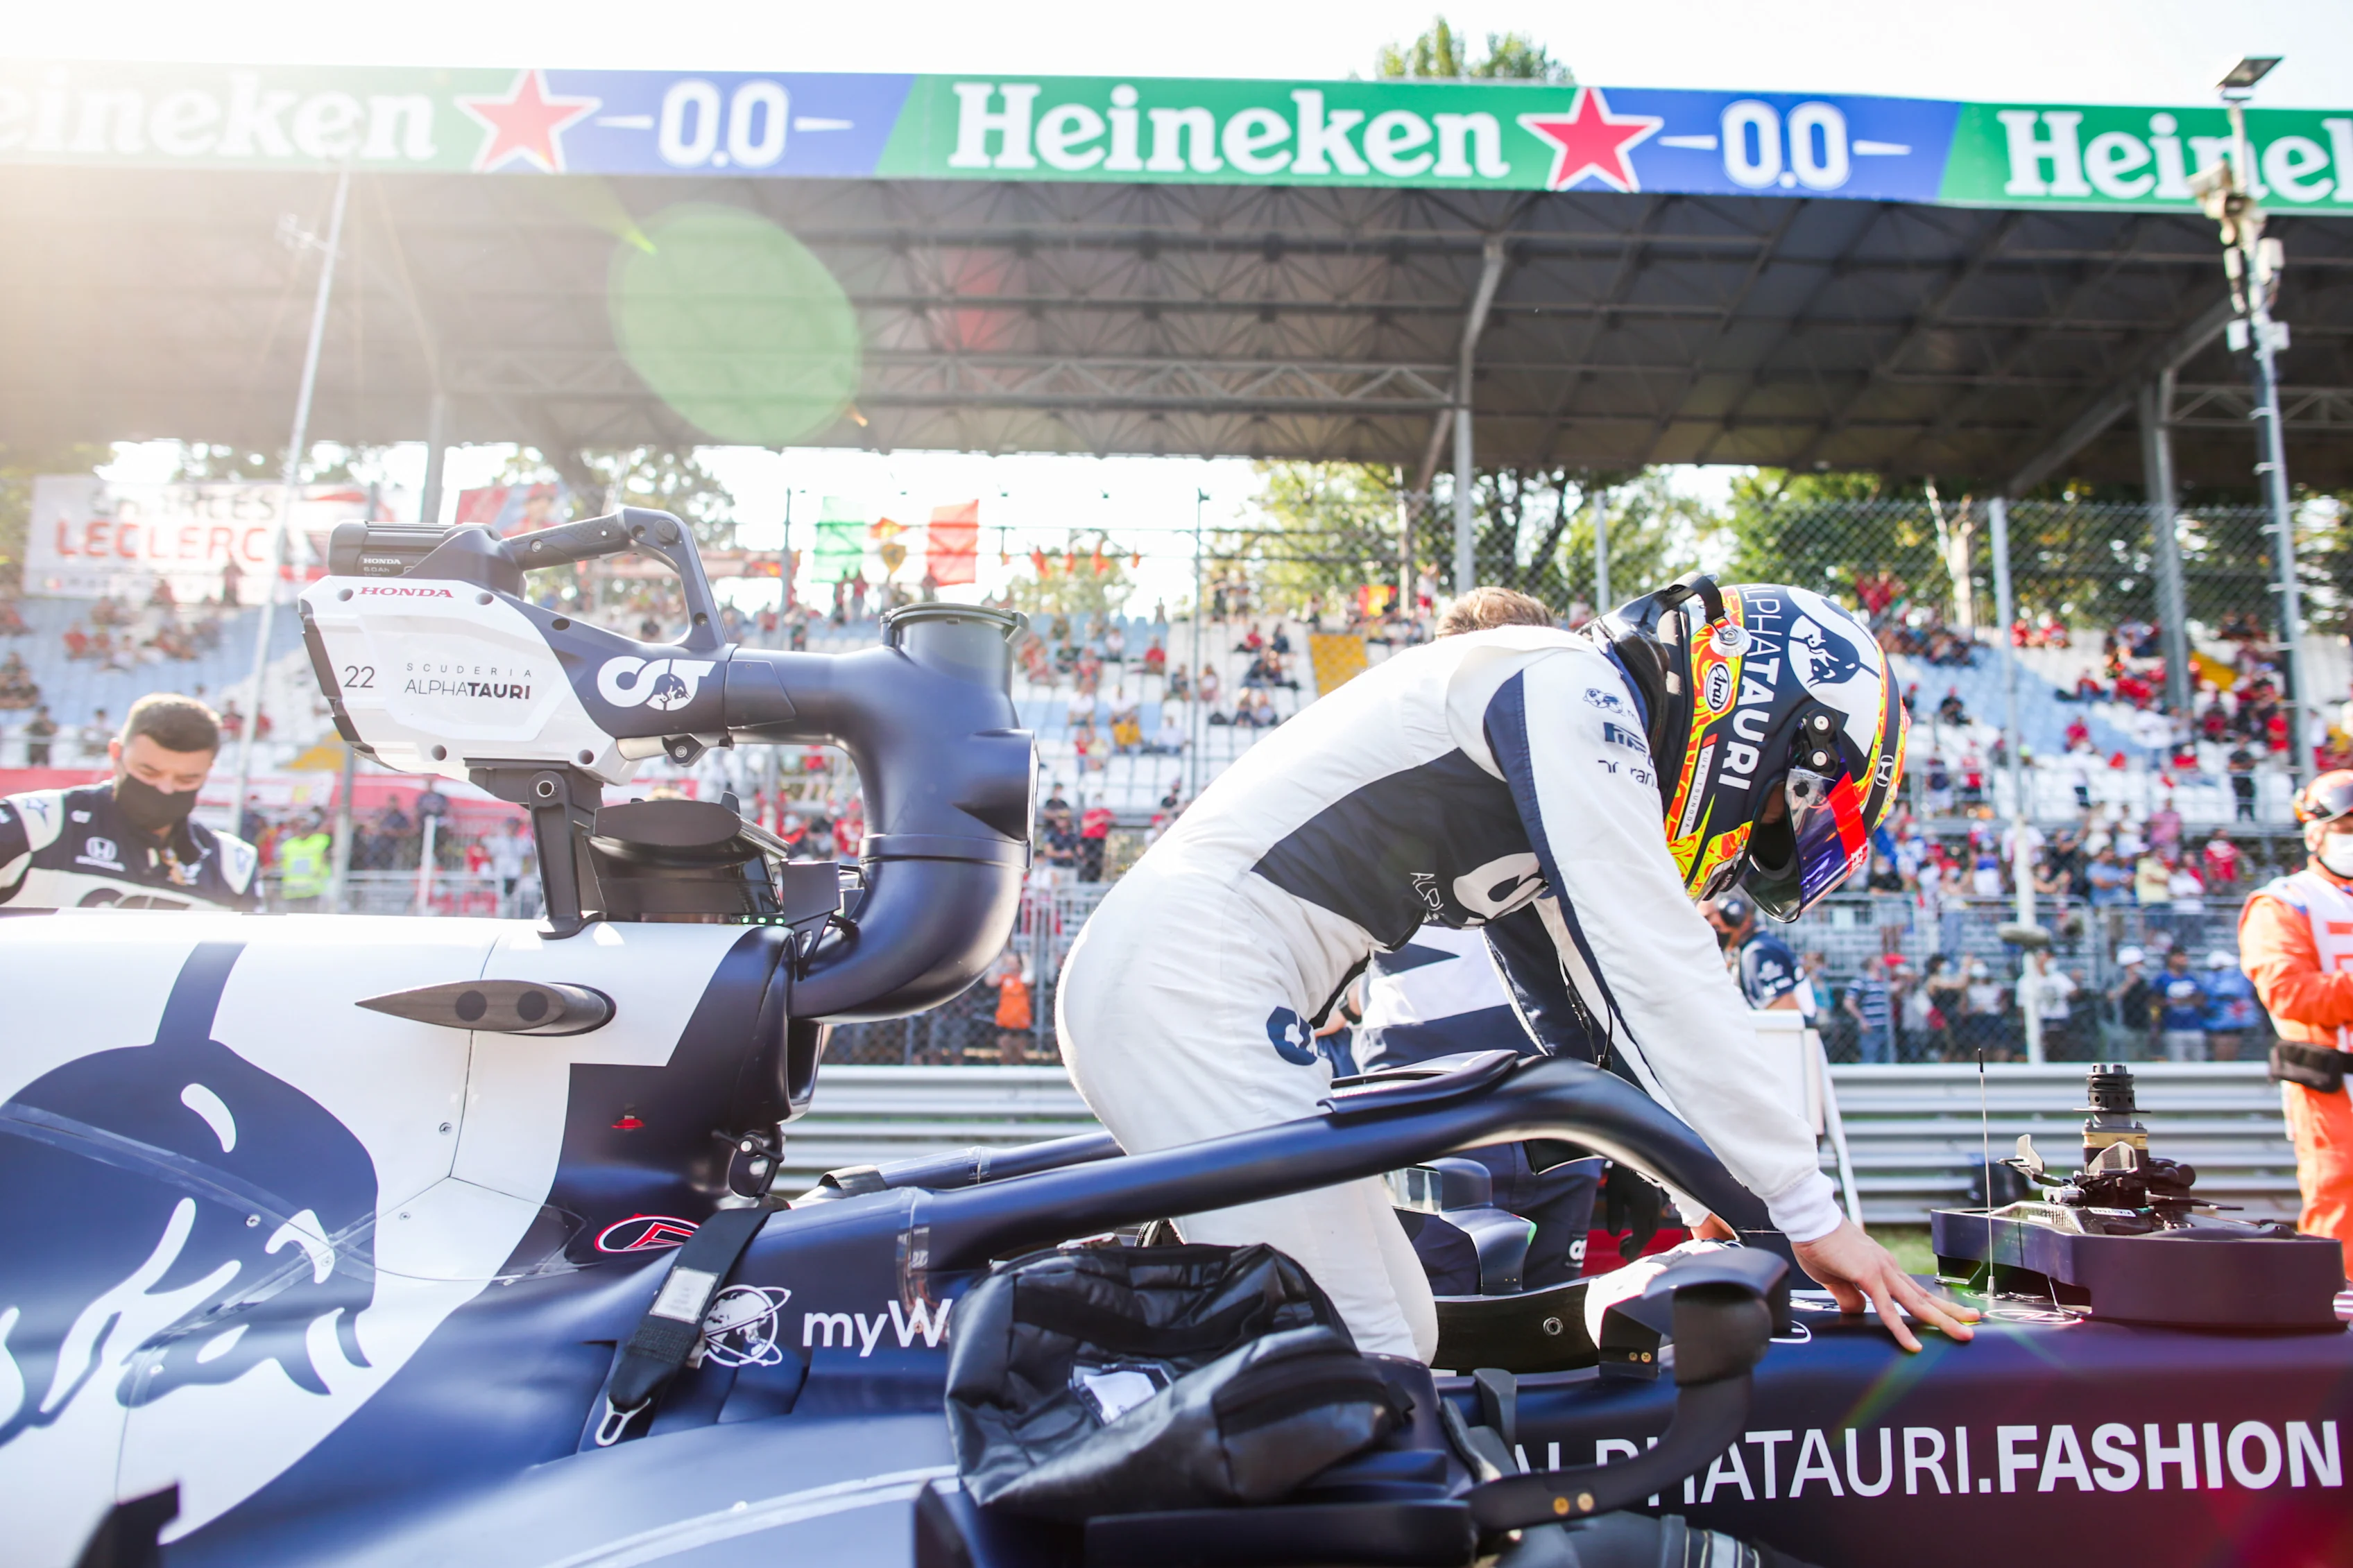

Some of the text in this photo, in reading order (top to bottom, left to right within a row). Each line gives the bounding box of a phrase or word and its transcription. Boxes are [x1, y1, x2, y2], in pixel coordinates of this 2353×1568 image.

[0, 66, 438, 161] ineken
[658, 79, 790, 167] 0.0
[948, 83, 1510, 178] Heineken
[1721, 100, 1850, 189] 0.0
[55, 519, 269, 562] LECLERC
[359, 587, 454, 598] HONDA
[343, 666, 375, 688] 22
[404, 679, 531, 700] ALPHATAURI
[407, 663, 531, 678] SCUDERIA
[1711, 666, 1729, 706] Arai
[1700, 750, 1710, 775] YUKI
[803, 1297, 952, 1357] myW
[1515, 1420, 2343, 1507] ATAURI.FASHION
